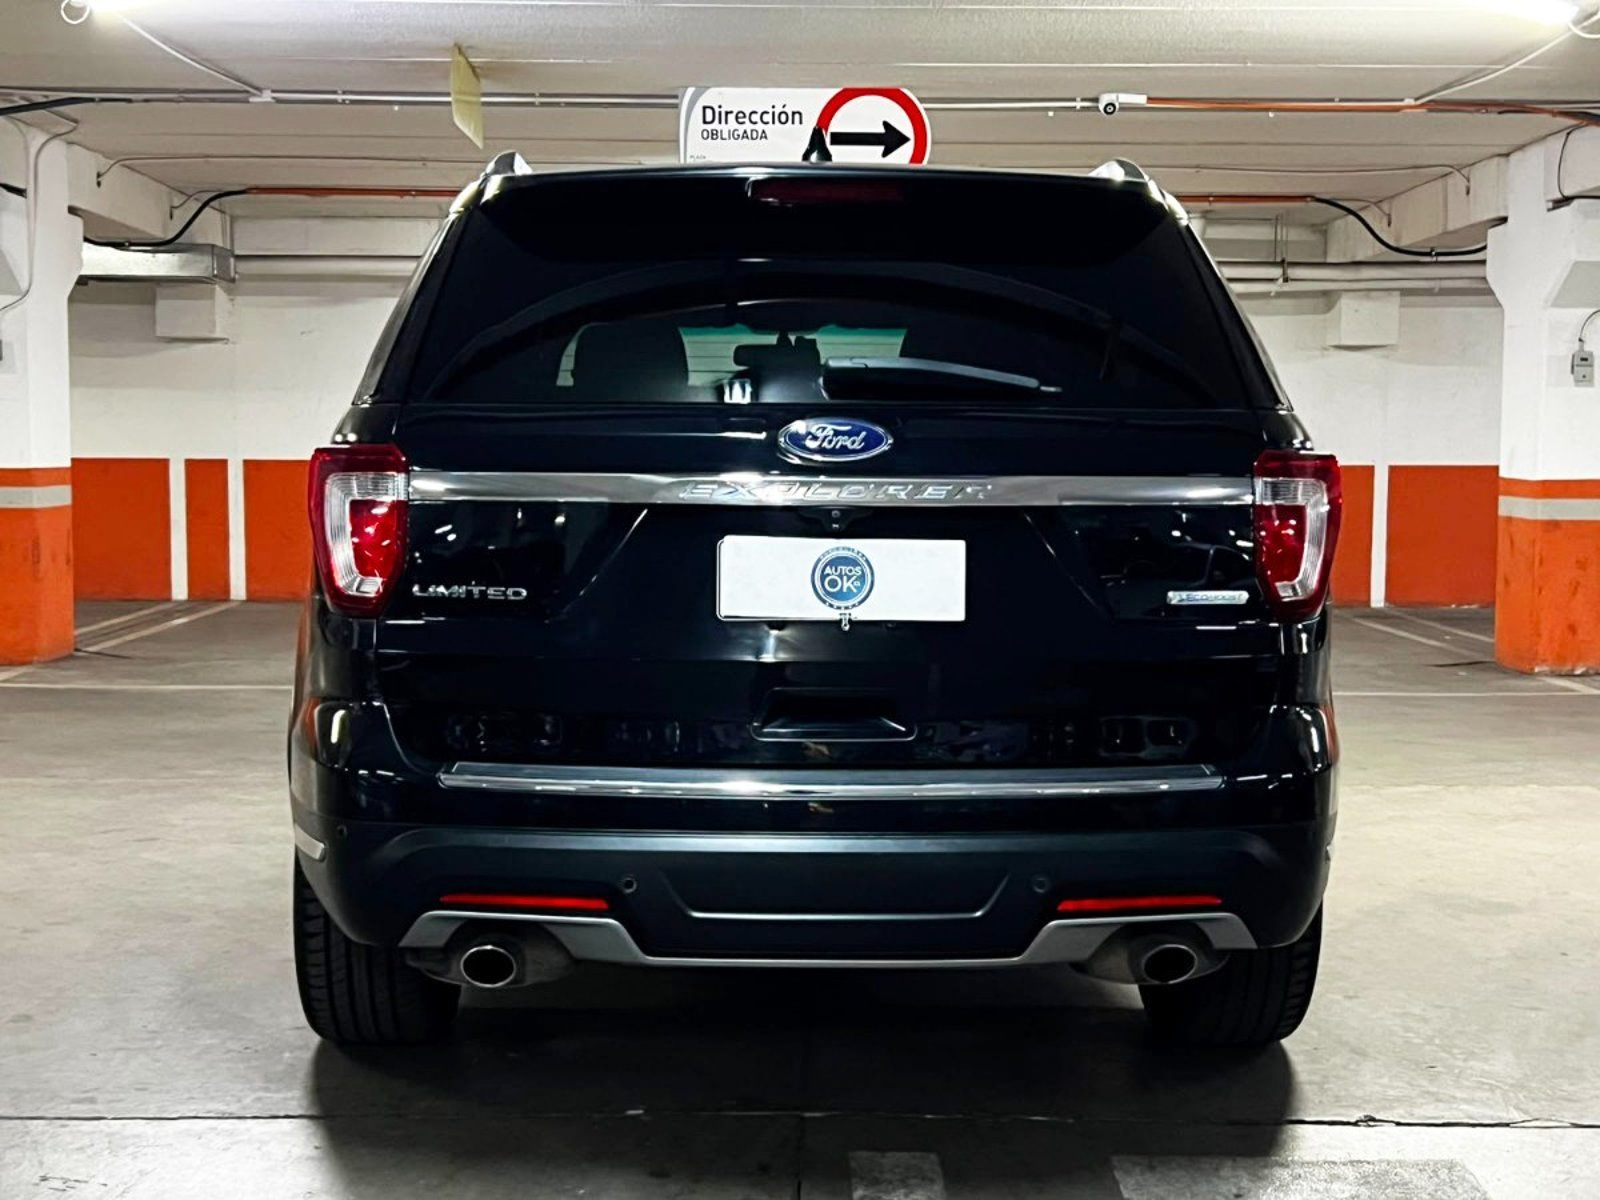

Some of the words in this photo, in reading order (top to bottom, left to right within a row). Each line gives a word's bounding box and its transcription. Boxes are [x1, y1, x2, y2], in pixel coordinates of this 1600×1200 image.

[701, 104, 803, 125] Dirección
[700, 129, 768, 140] OBLIGADA
[805, 423, 866, 450] Ford
[823, 565, 862, 576] AUTOS
[824, 575, 857, 592] OK
[411, 584, 528, 600] LIMITED
